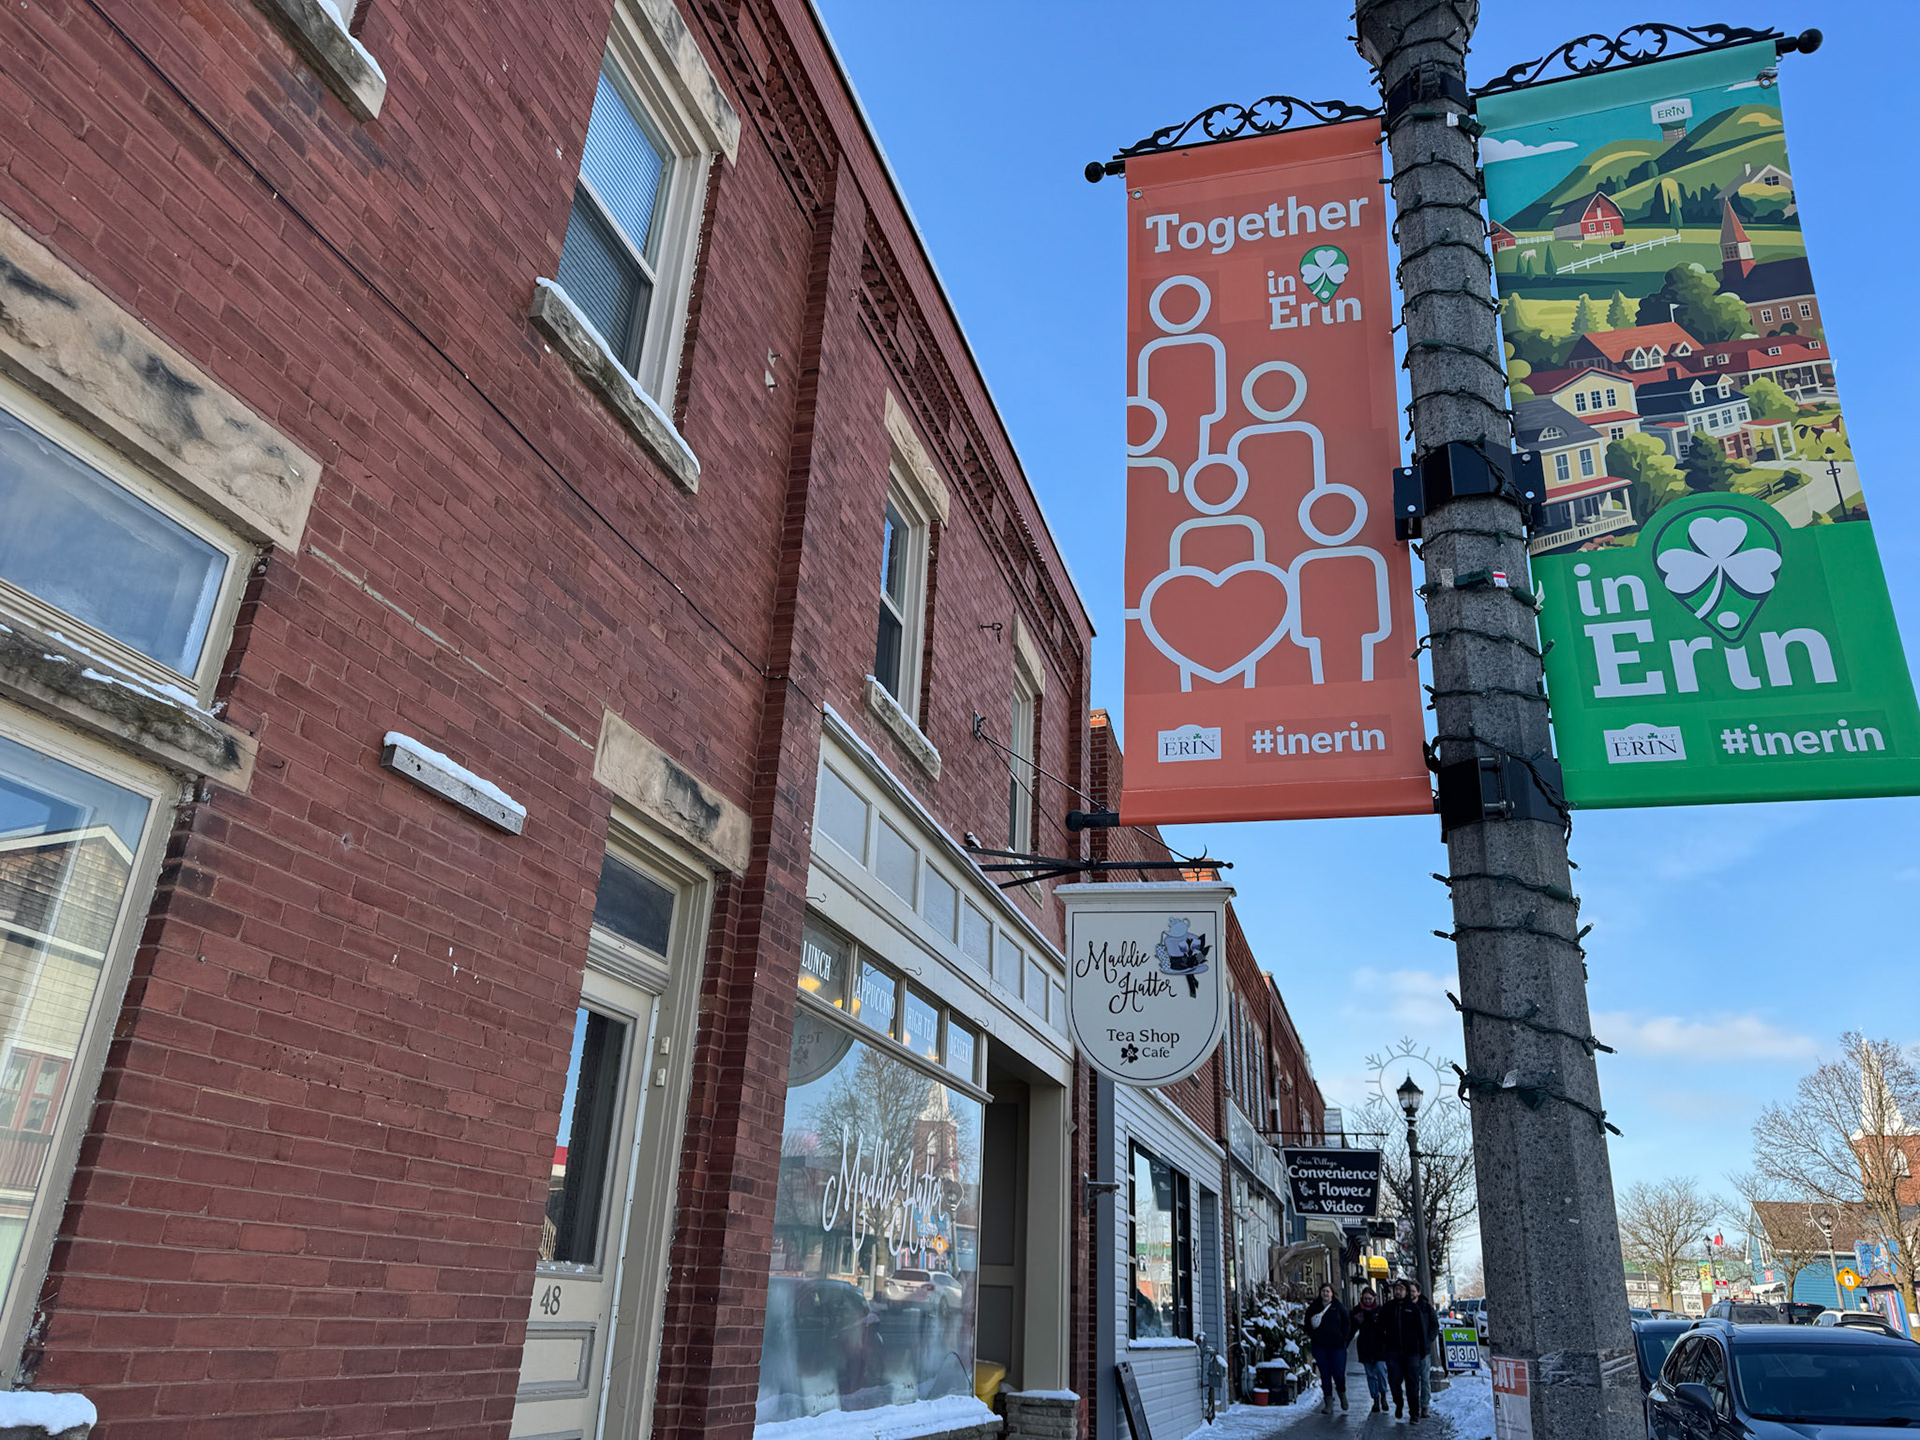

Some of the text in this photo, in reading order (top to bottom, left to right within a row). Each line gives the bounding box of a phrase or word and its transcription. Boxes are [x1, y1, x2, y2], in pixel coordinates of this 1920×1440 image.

[1657, 106, 1685, 119] ERIN
[1145, 196, 1369, 255] Together
[1267, 270, 1297, 295] in
[1269, 295, 1363, 330] Erin
[1574, 563, 1650, 617] in
[1583, 619, 1838, 699] Erin
[1163, 740, 1216, 757] ERIN
[1252, 721, 1386, 755] #inerin
[1612, 739, 1677, 758] ERIN
[1720, 718, 1885, 757] #inerin
[801, 940, 832, 982] LUNCH
[1076, 940, 1150, 984] Maddie
[853, 973, 896, 1020] CAPPUCCINO
[1109, 971, 1178, 1014] Hatter
[907, 1007, 934, 1043] HIGH TEA
[1106, 1028, 1180, 1048] Tea Shop
[1142, 1046, 1170, 1058] Cafe
[1288, 1165, 1378, 1180] Convenience
[1318, 1181, 1371, 1197] Flowers
[823, 1124, 949, 1256] Maddie Hatter
[1320, 1199, 1365, 1213] Video
[540, 1285, 562, 1315] 48
